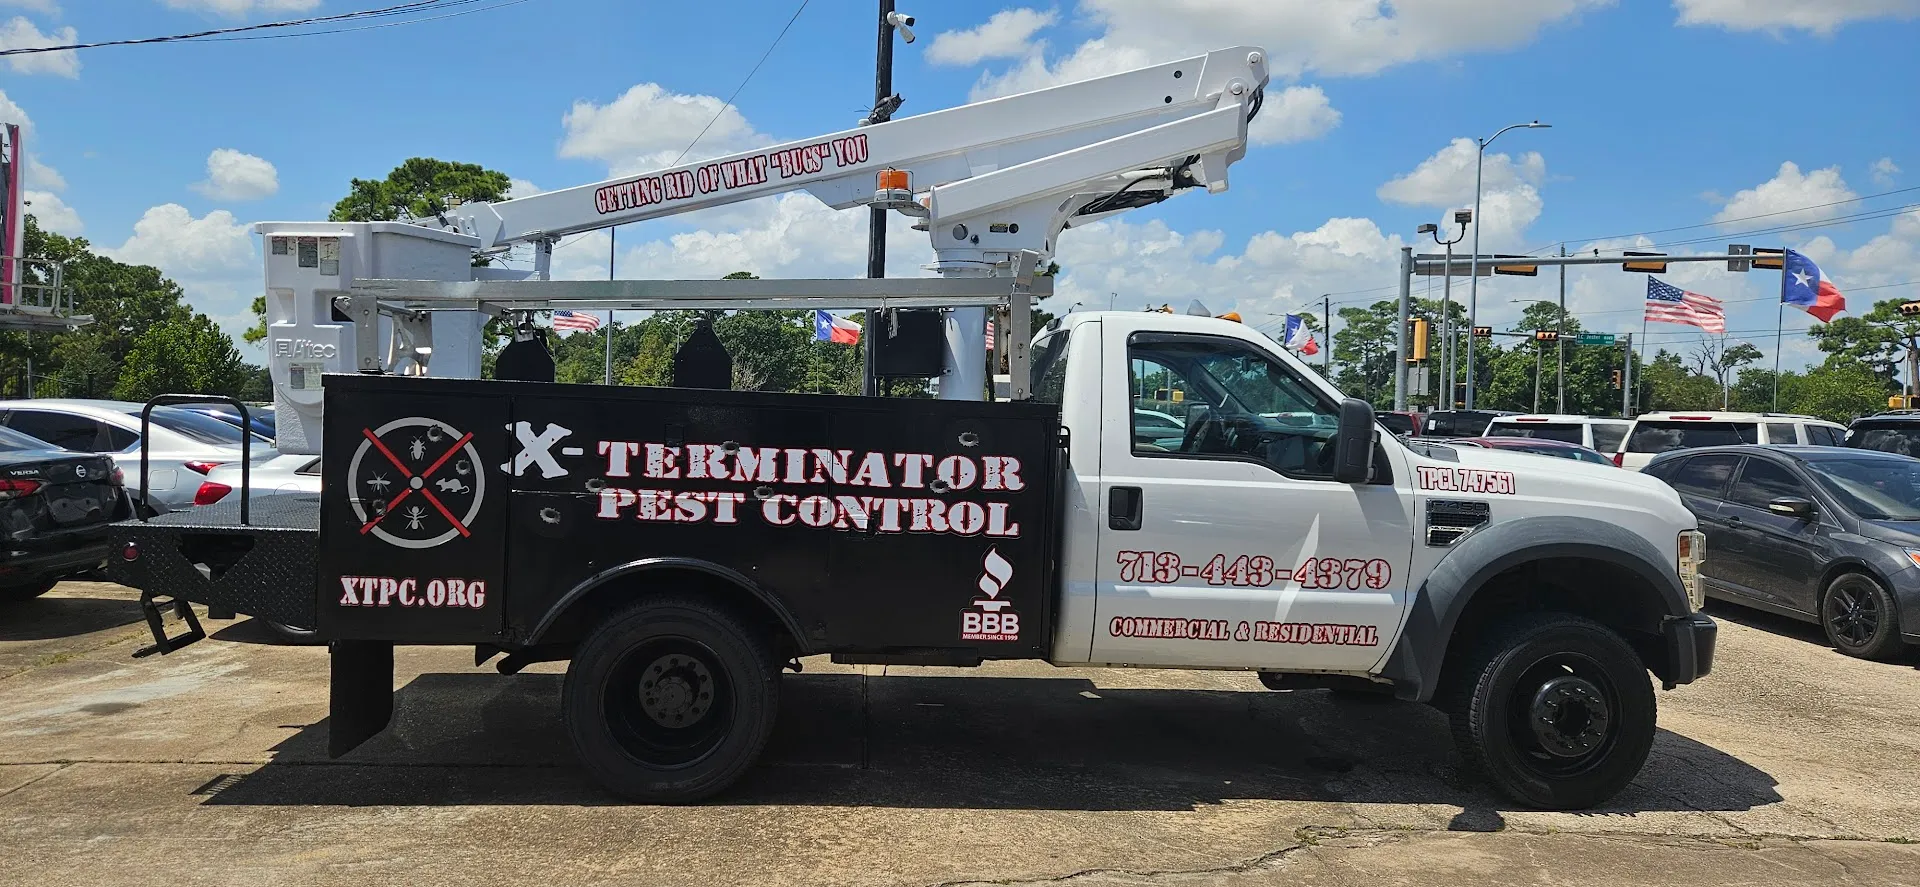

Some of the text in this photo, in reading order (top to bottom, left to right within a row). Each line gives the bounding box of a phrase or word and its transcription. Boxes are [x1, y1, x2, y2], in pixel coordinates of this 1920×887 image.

[595, 174, 662, 214] GETTING
[663, 168, 694, 200] RID
[697, 163, 719, 195] OF
[720, 154, 767, 189] WHAT
[832, 134, 868, 167] YOU
[596, 439, 1026, 493] TERMINATOR
[1417, 466, 1516, 495] TPCL 747561
[596, 487, 1023, 539] PEST CONTROL
[1116, 550, 1392, 590] 713-443-4379
[339, 575, 486, 609] XTPC.ORG
[963, 612, 1020, 634] BBB
[1109, 616, 1379, 646] COMMERCIAL & RESIDENTIAL
